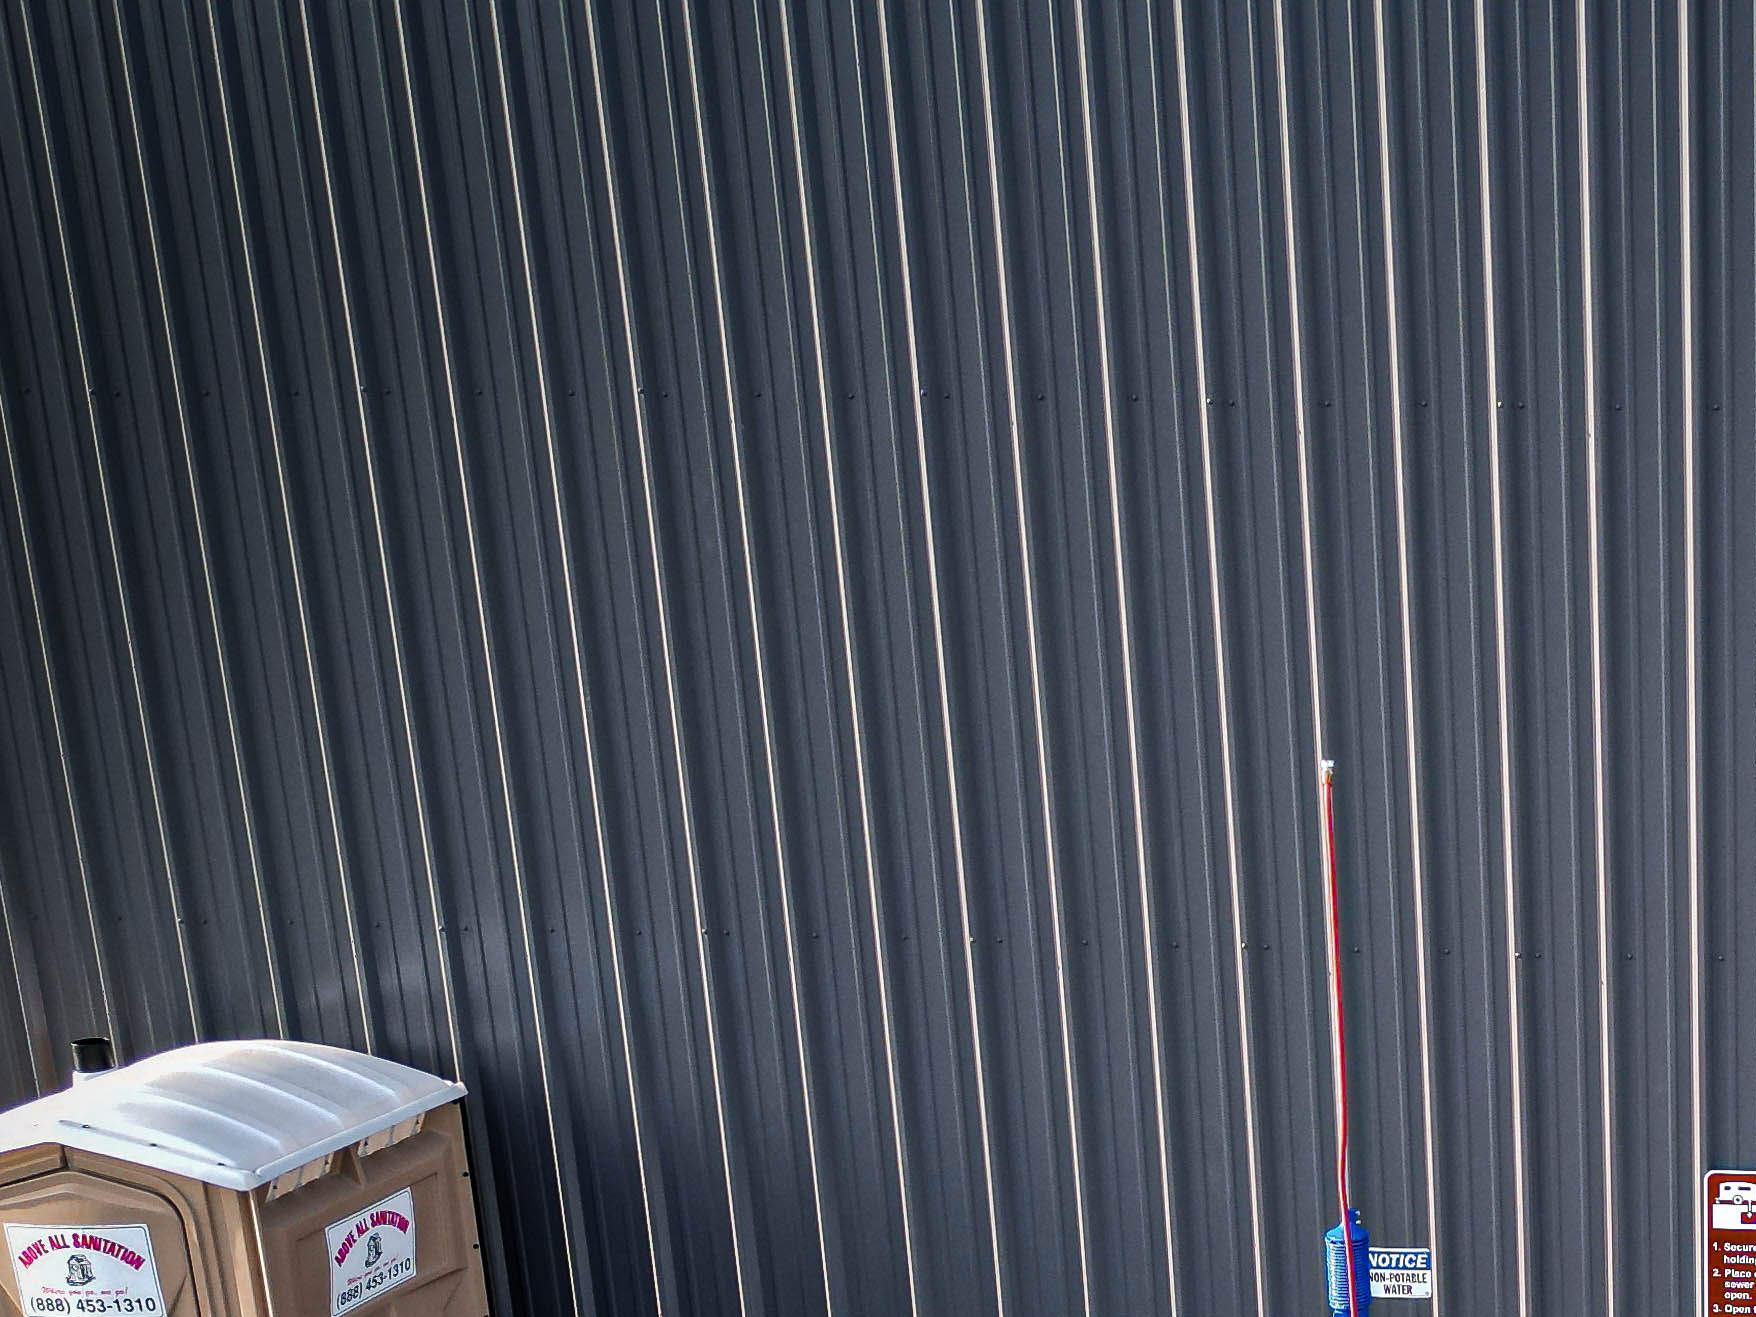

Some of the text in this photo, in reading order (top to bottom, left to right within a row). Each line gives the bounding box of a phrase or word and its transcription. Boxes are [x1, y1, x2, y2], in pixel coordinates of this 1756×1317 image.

[334, 1230, 357, 1268] ABOVE
[356, 1218, 369, 1238] ALL
[18, 1233, 146, 1270] ABOVE ALL SANITATION
[1713, 1269, 1721, 1277] 2.
[1725, 1269, 1751, 1278] Place
[337, 1283, 362, 1310] (888)
[366, 1258, 411, 1290] 453-1310
[1384, 1285, 1412, 1294] WATER
[1724, 1292, 1752, 1300] open.
[31, 1297, 156, 1314] (888) 453-1310
[1713, 1304, 1722, 1313] 3.
[1725, 1304, 1751, 1314] Open
